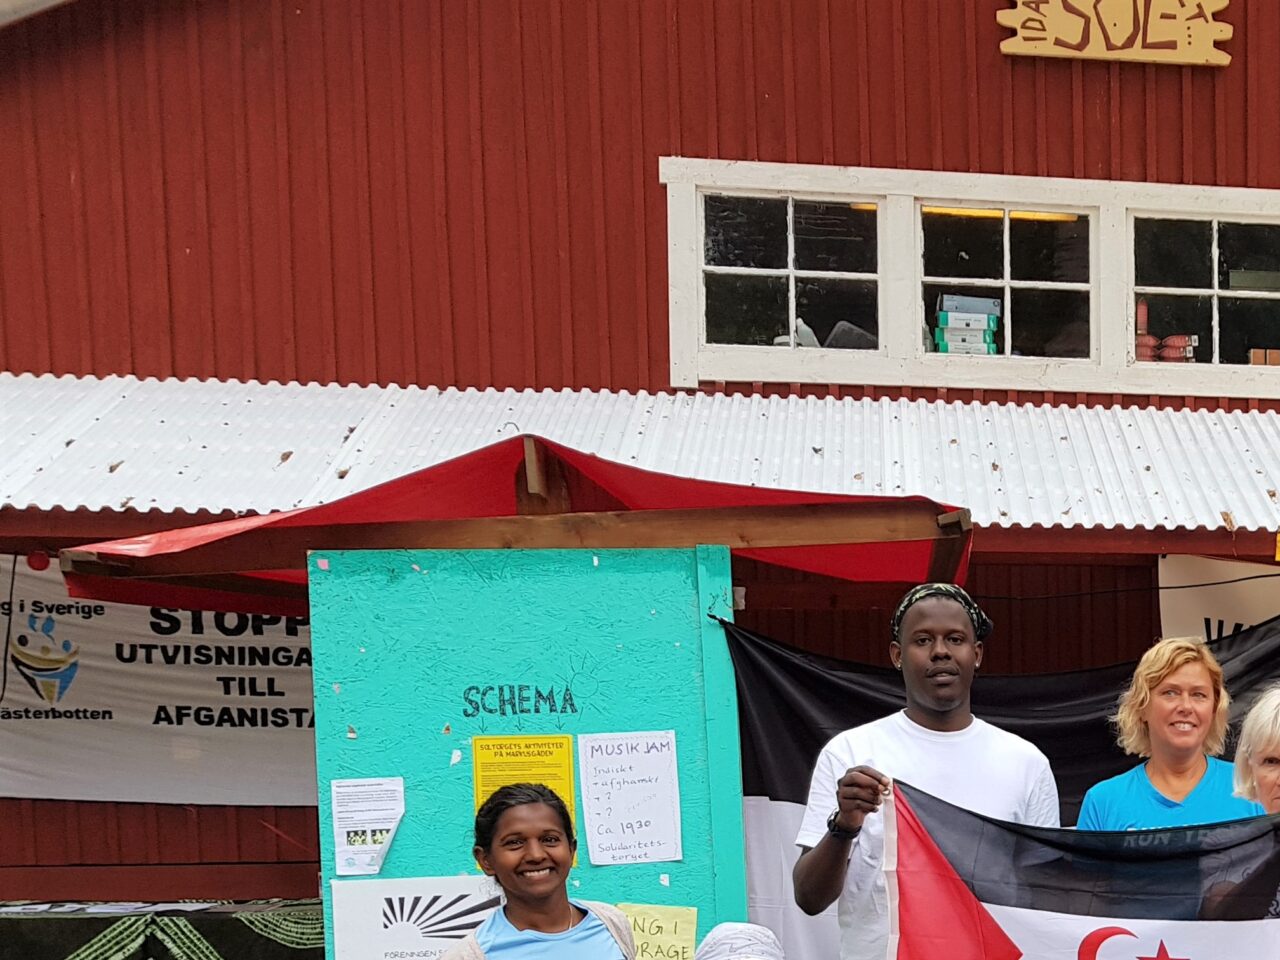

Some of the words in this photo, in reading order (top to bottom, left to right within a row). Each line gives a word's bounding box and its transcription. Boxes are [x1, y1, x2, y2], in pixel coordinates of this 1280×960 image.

[19, 600, 25, 612] i
[31, 600, 105, 620] Sverige
[216, 676, 286, 697] TILL
[462, 684, 579, 717] SCHEMA
[590, 742, 640, 759] MUSIK
[643, 741, 671, 754] JAM
[597, 823, 614, 836] Ca
[620, 819, 652, 835] 1930
